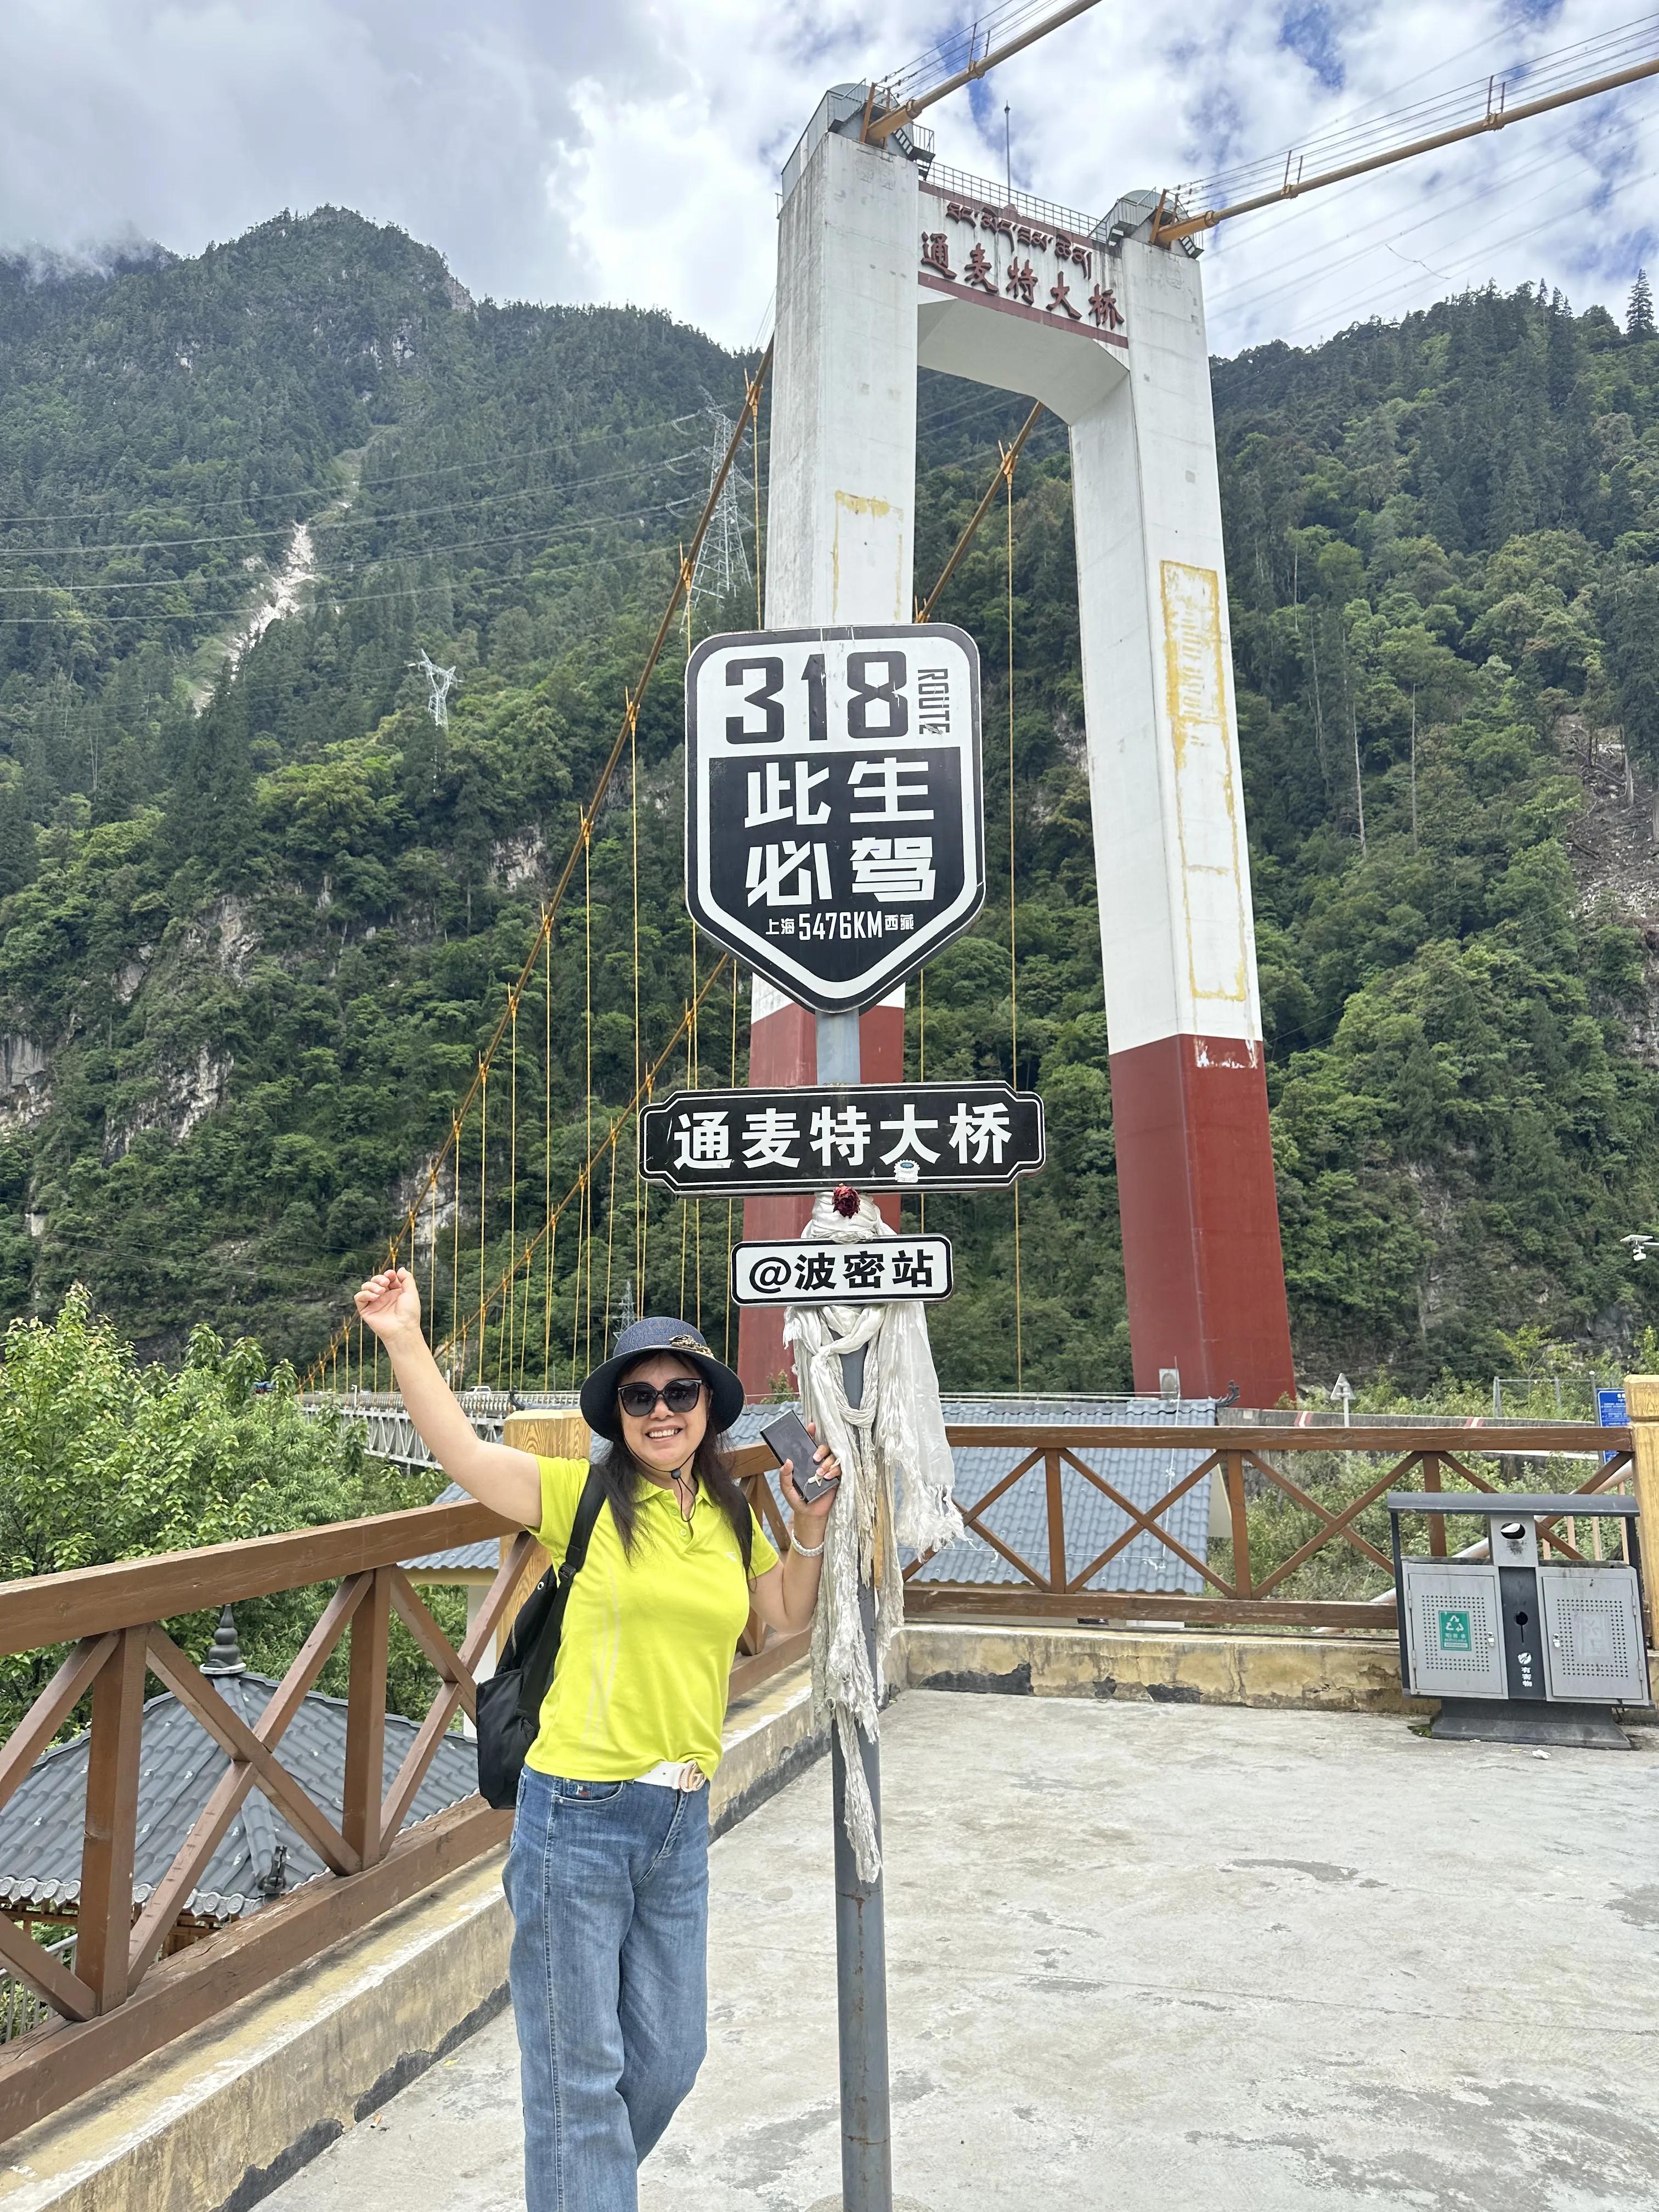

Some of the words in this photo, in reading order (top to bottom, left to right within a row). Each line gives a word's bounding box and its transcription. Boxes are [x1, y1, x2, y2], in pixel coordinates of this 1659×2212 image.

[921, 231, 1125, 330] 通麦特大桥
[726, 651, 909, 744] 318
[917, 668, 950, 735] ROUTE
[744, 757, 934, 828] 此生
[745, 837, 936, 907] 必驾
[765, 918, 795, 935] 上海
[799, 911, 882, 940] 5476KM
[884, 913, 914, 931] 西藏
[673, 1102, 1012, 1170] 通麦特大桥
[749, 1249, 934, 1294] @波密站
